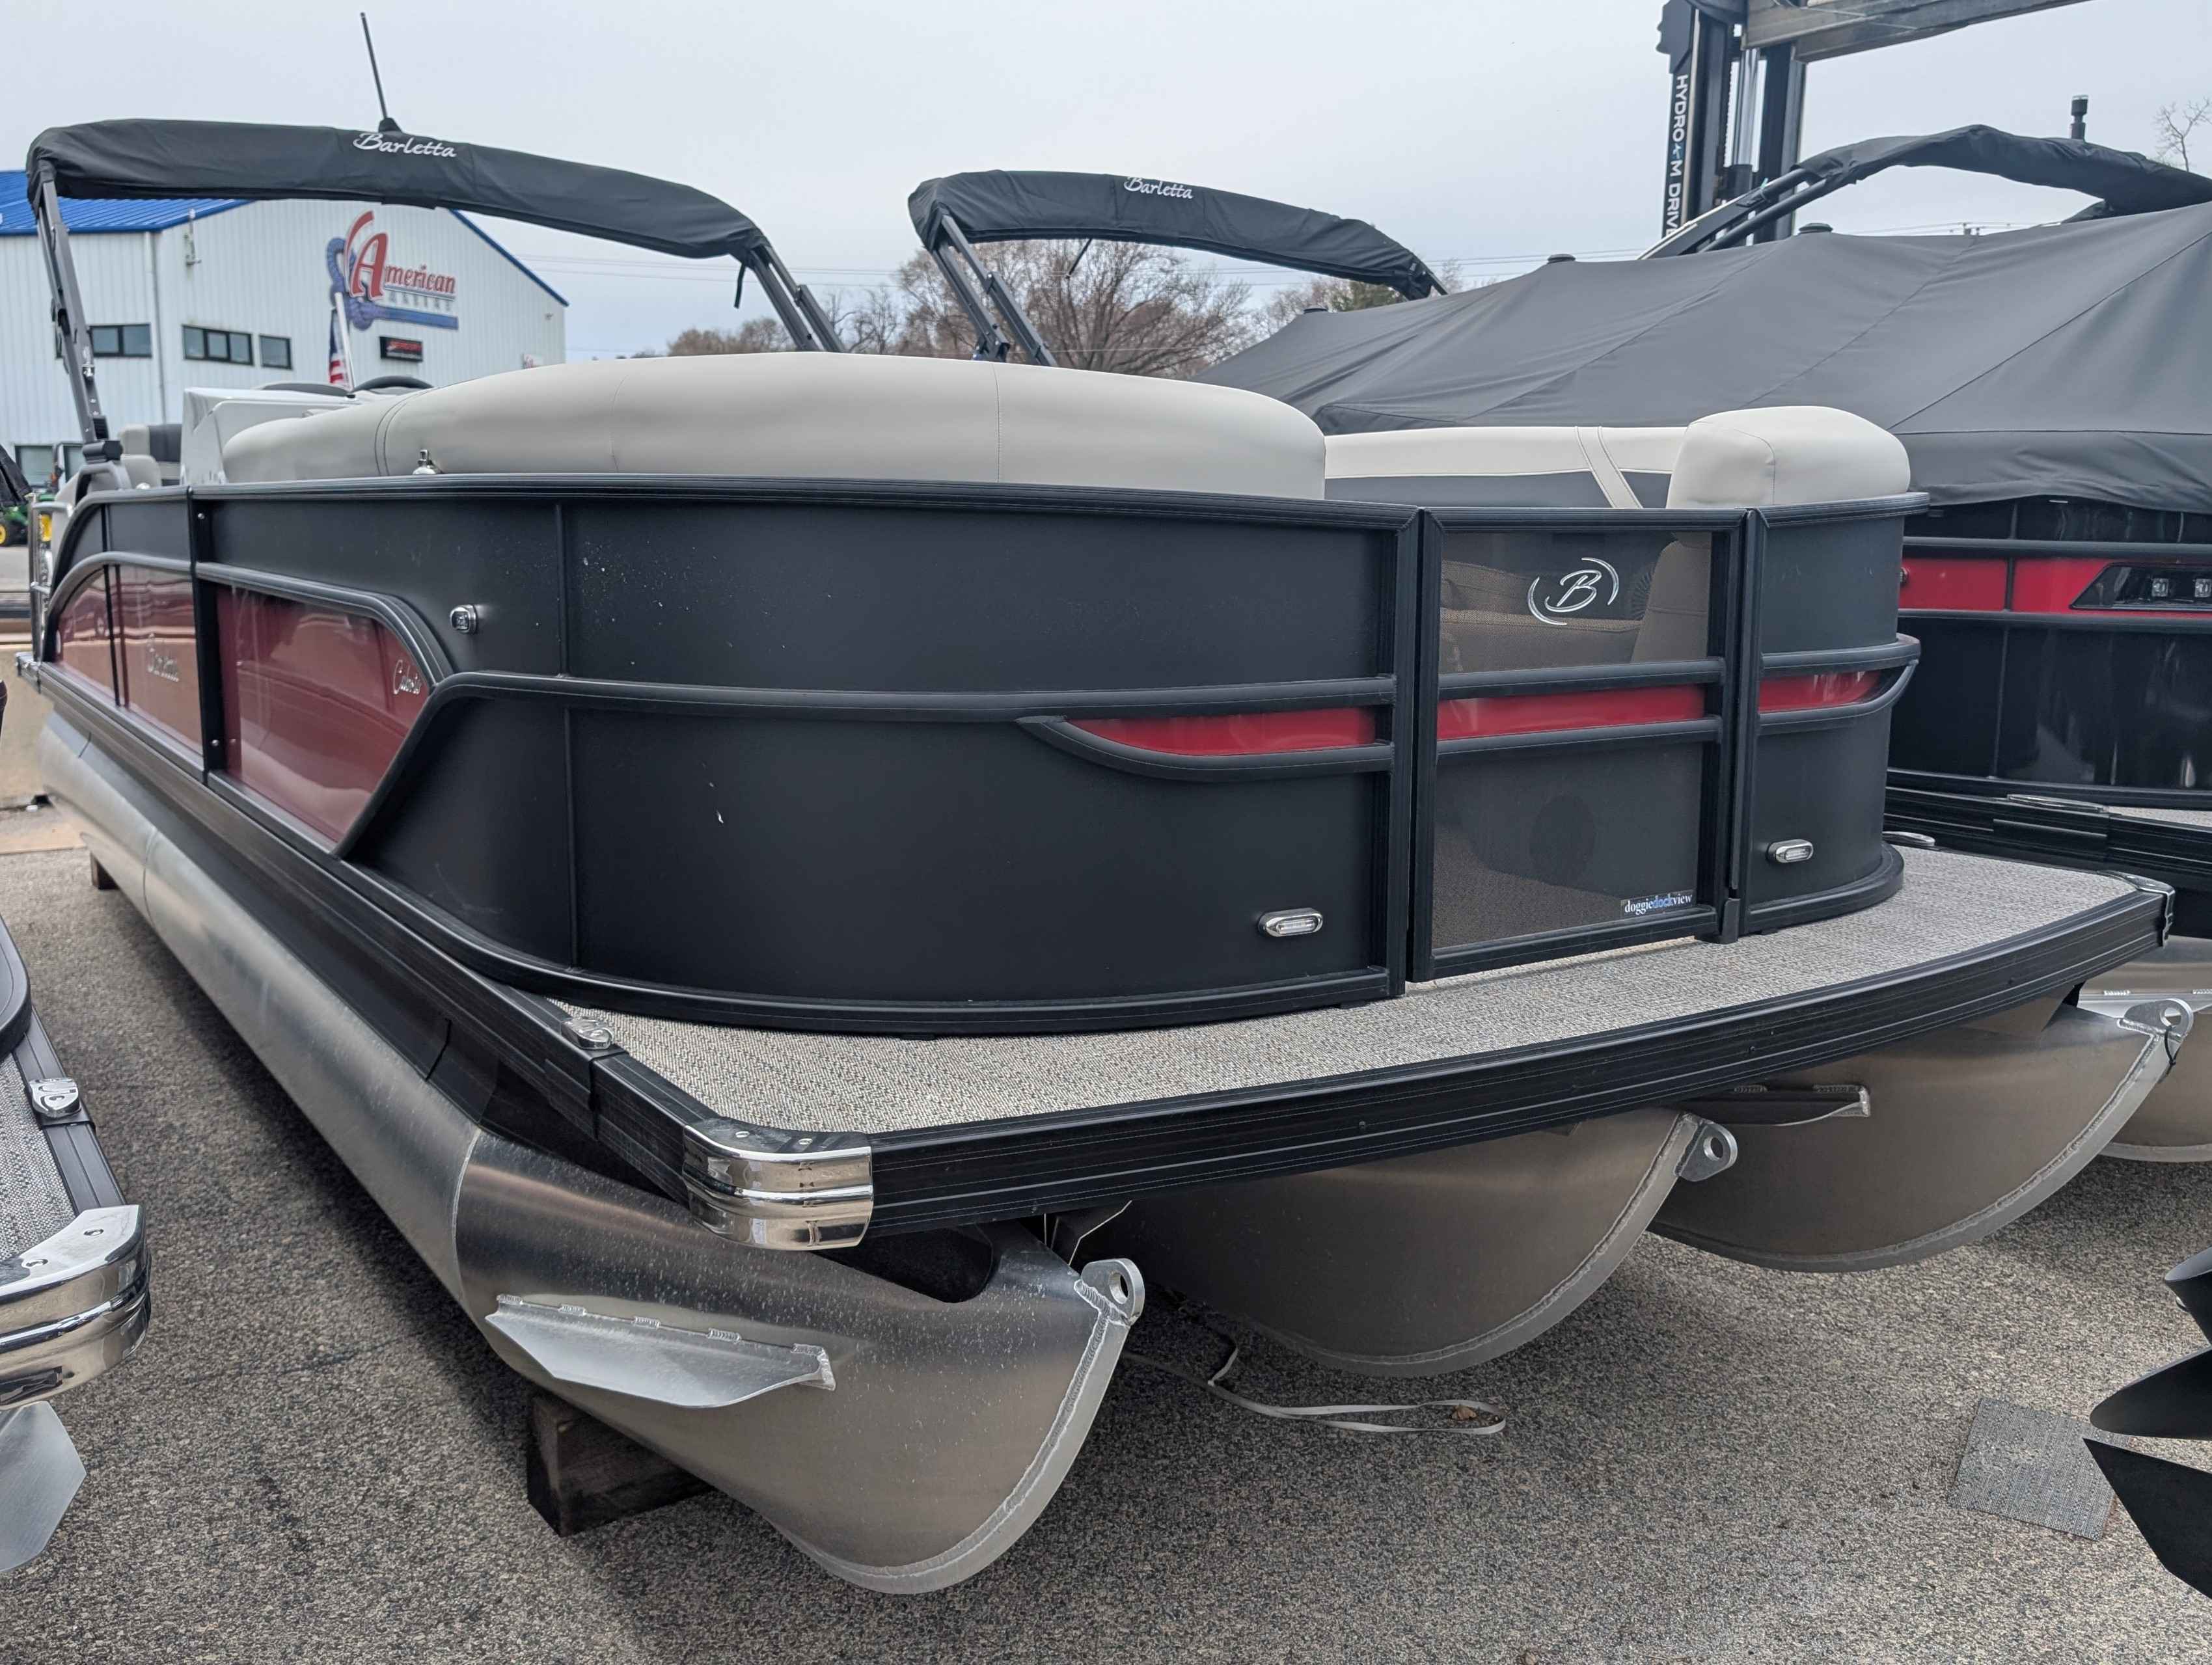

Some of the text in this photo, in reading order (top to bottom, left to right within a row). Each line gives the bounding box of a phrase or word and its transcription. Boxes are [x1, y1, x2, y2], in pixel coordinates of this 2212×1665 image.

[1672, 74, 1689, 142] HYDRO
[353, 132, 457, 158] Barletta
[1123, 176, 1194, 199] Barletta
[349, 232, 456, 300] American
[1624, 892, 1693, 916] doggiedockview
